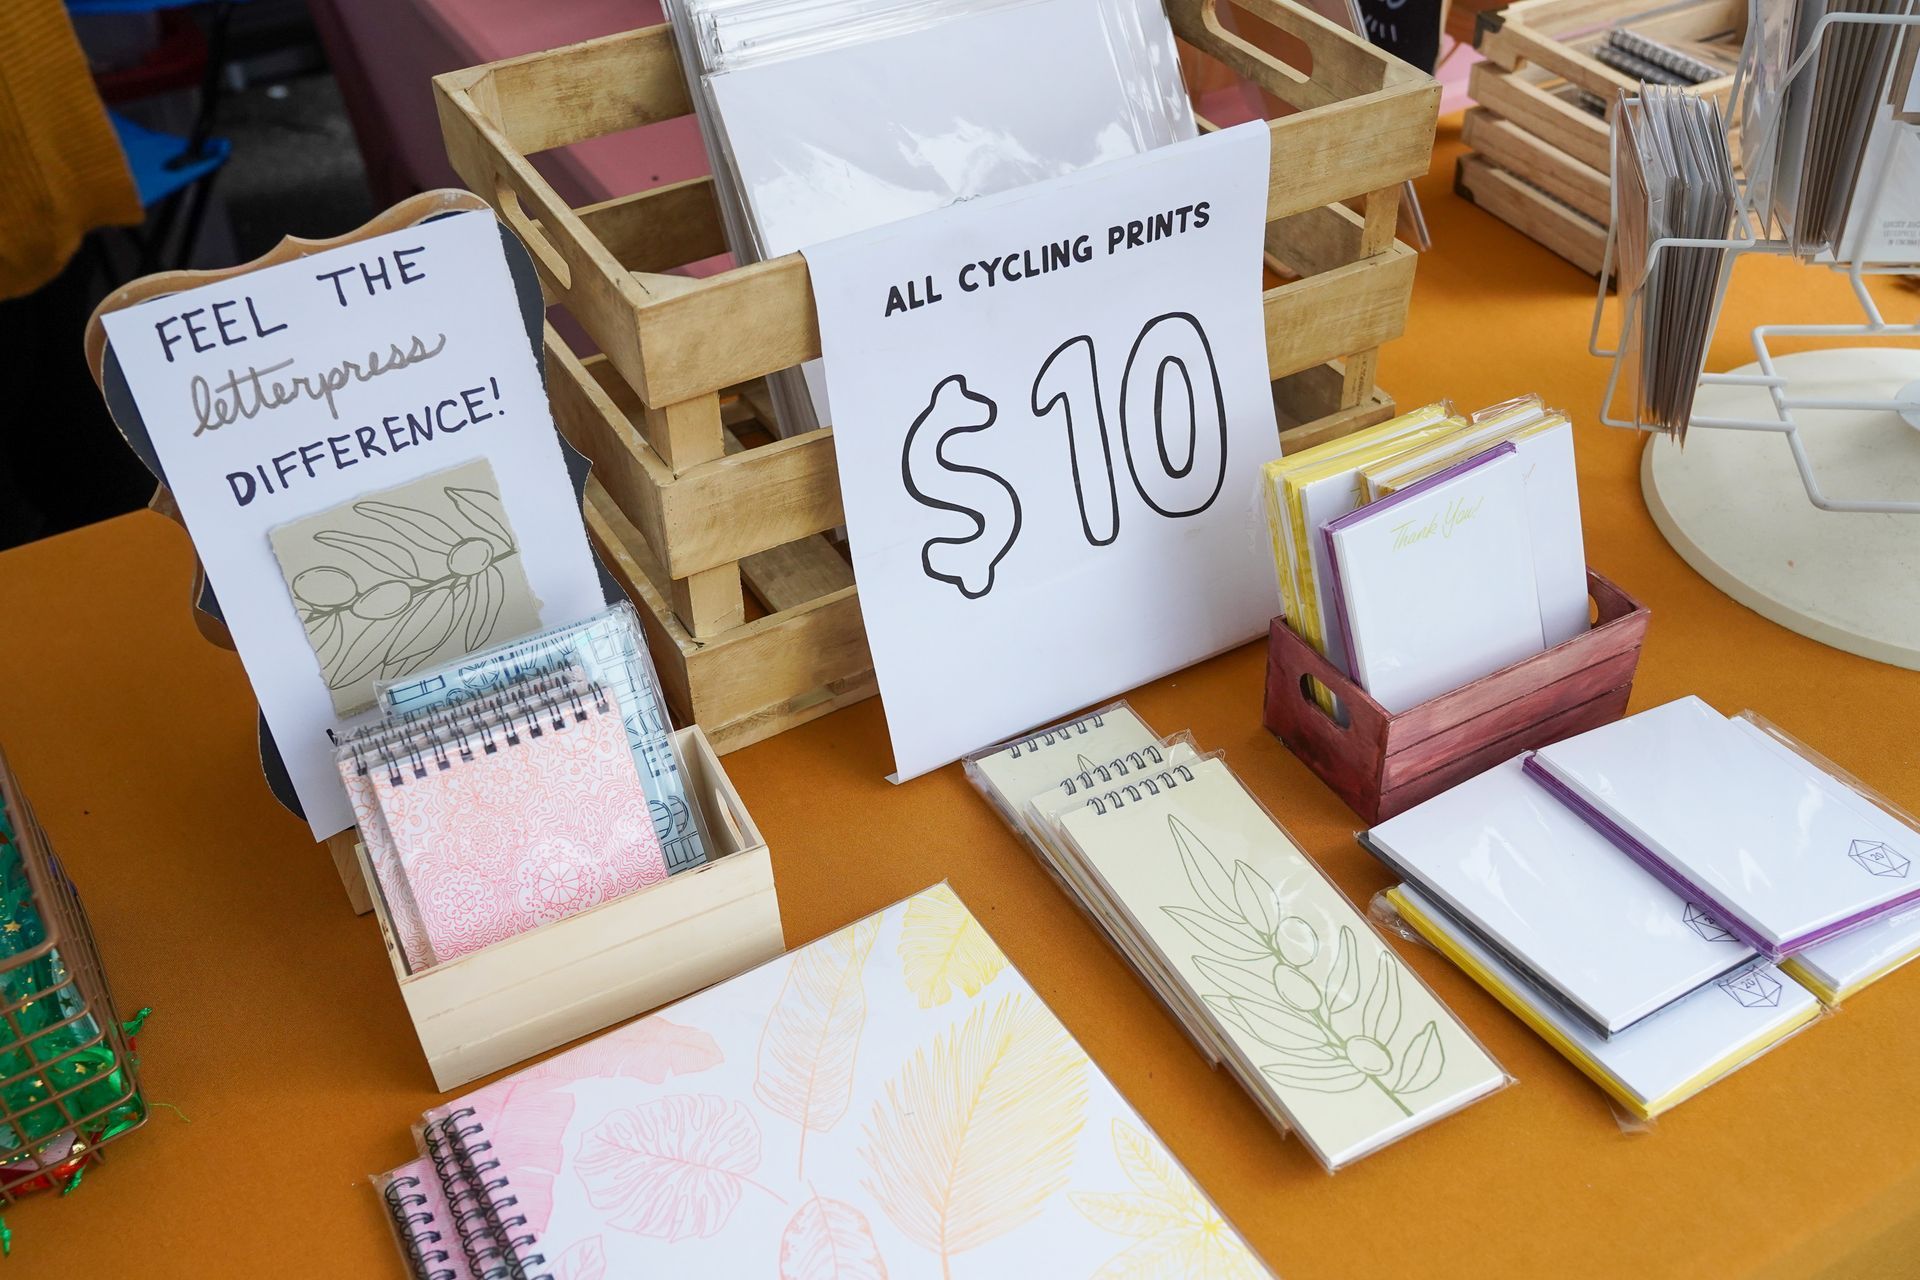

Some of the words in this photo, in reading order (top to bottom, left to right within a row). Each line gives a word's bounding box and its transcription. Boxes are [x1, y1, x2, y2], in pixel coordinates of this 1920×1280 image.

[155, 297, 287, 362] FEEL
[316, 246, 426, 306] THE
[884, 275, 942, 317] ALL
[958, 235, 1092, 292] CYCLING
[1108, 202, 1210, 254] PRINTS
[193, 333, 446, 437] letterpress
[226, 377, 505, 507] DIFFERENCE!
[902, 311, 1227, 599] $10
[1391, 512, 1439, 551] Thank
